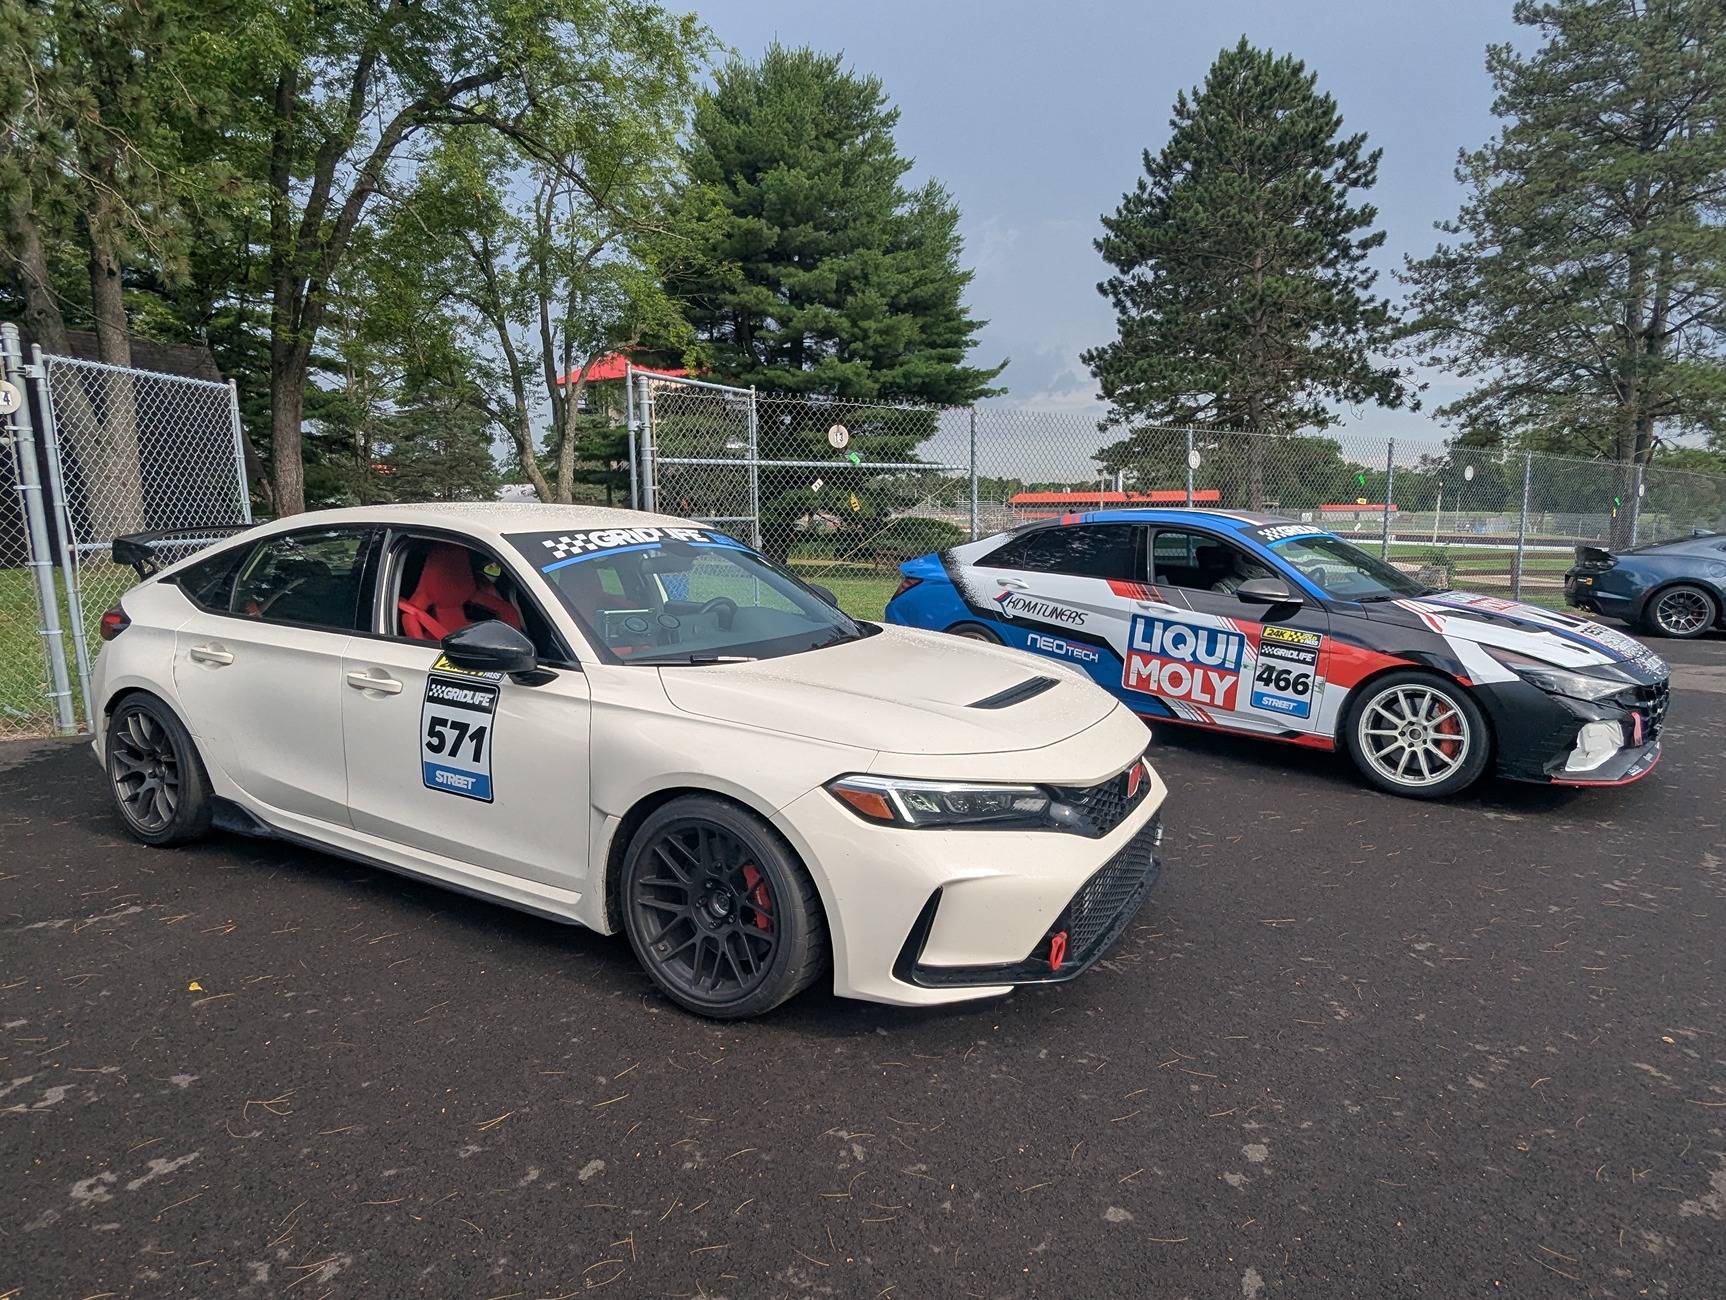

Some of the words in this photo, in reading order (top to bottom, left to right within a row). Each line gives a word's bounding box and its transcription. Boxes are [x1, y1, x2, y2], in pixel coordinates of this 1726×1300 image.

[1006, 596, 1088, 625] KDMTUNERS
[1132, 618, 1239, 669] LIQUI
[1266, 628, 1287, 638] 24K
[1273, 648, 1315, 662] GRIDLIFE
[1129, 654, 1237, 706] MOLY
[1255, 663, 1311, 696] 466
[443, 686, 494, 706] GRIDLIFE
[1261, 696, 1297, 710] STREET
[425, 715, 488, 763] 571
[435, 769, 476, 790] STREET
